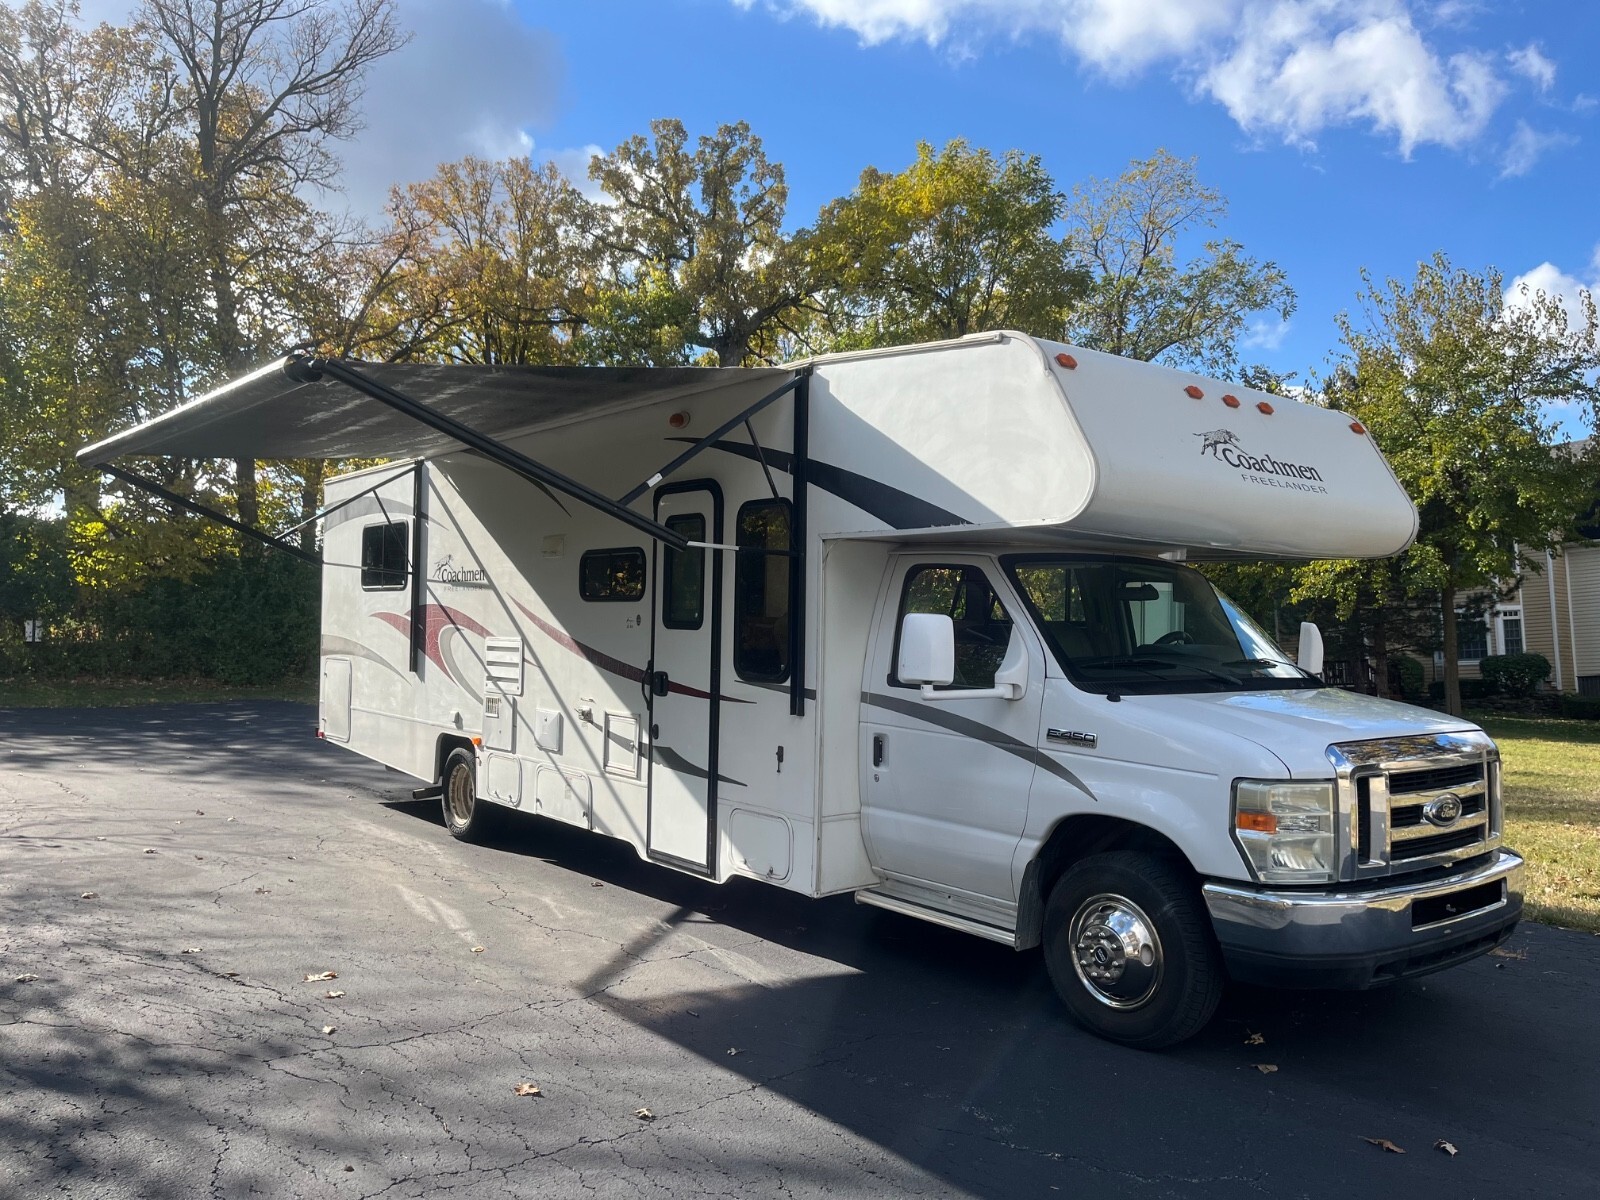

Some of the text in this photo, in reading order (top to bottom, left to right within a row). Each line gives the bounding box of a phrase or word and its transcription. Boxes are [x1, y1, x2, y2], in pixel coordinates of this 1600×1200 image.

[1222, 448, 1324, 482] Coachmen
[1241, 473, 1328, 494] FREELANDER
[441, 566, 485, 583] Coachmen
[1441, 803, 1457, 818] Ford
